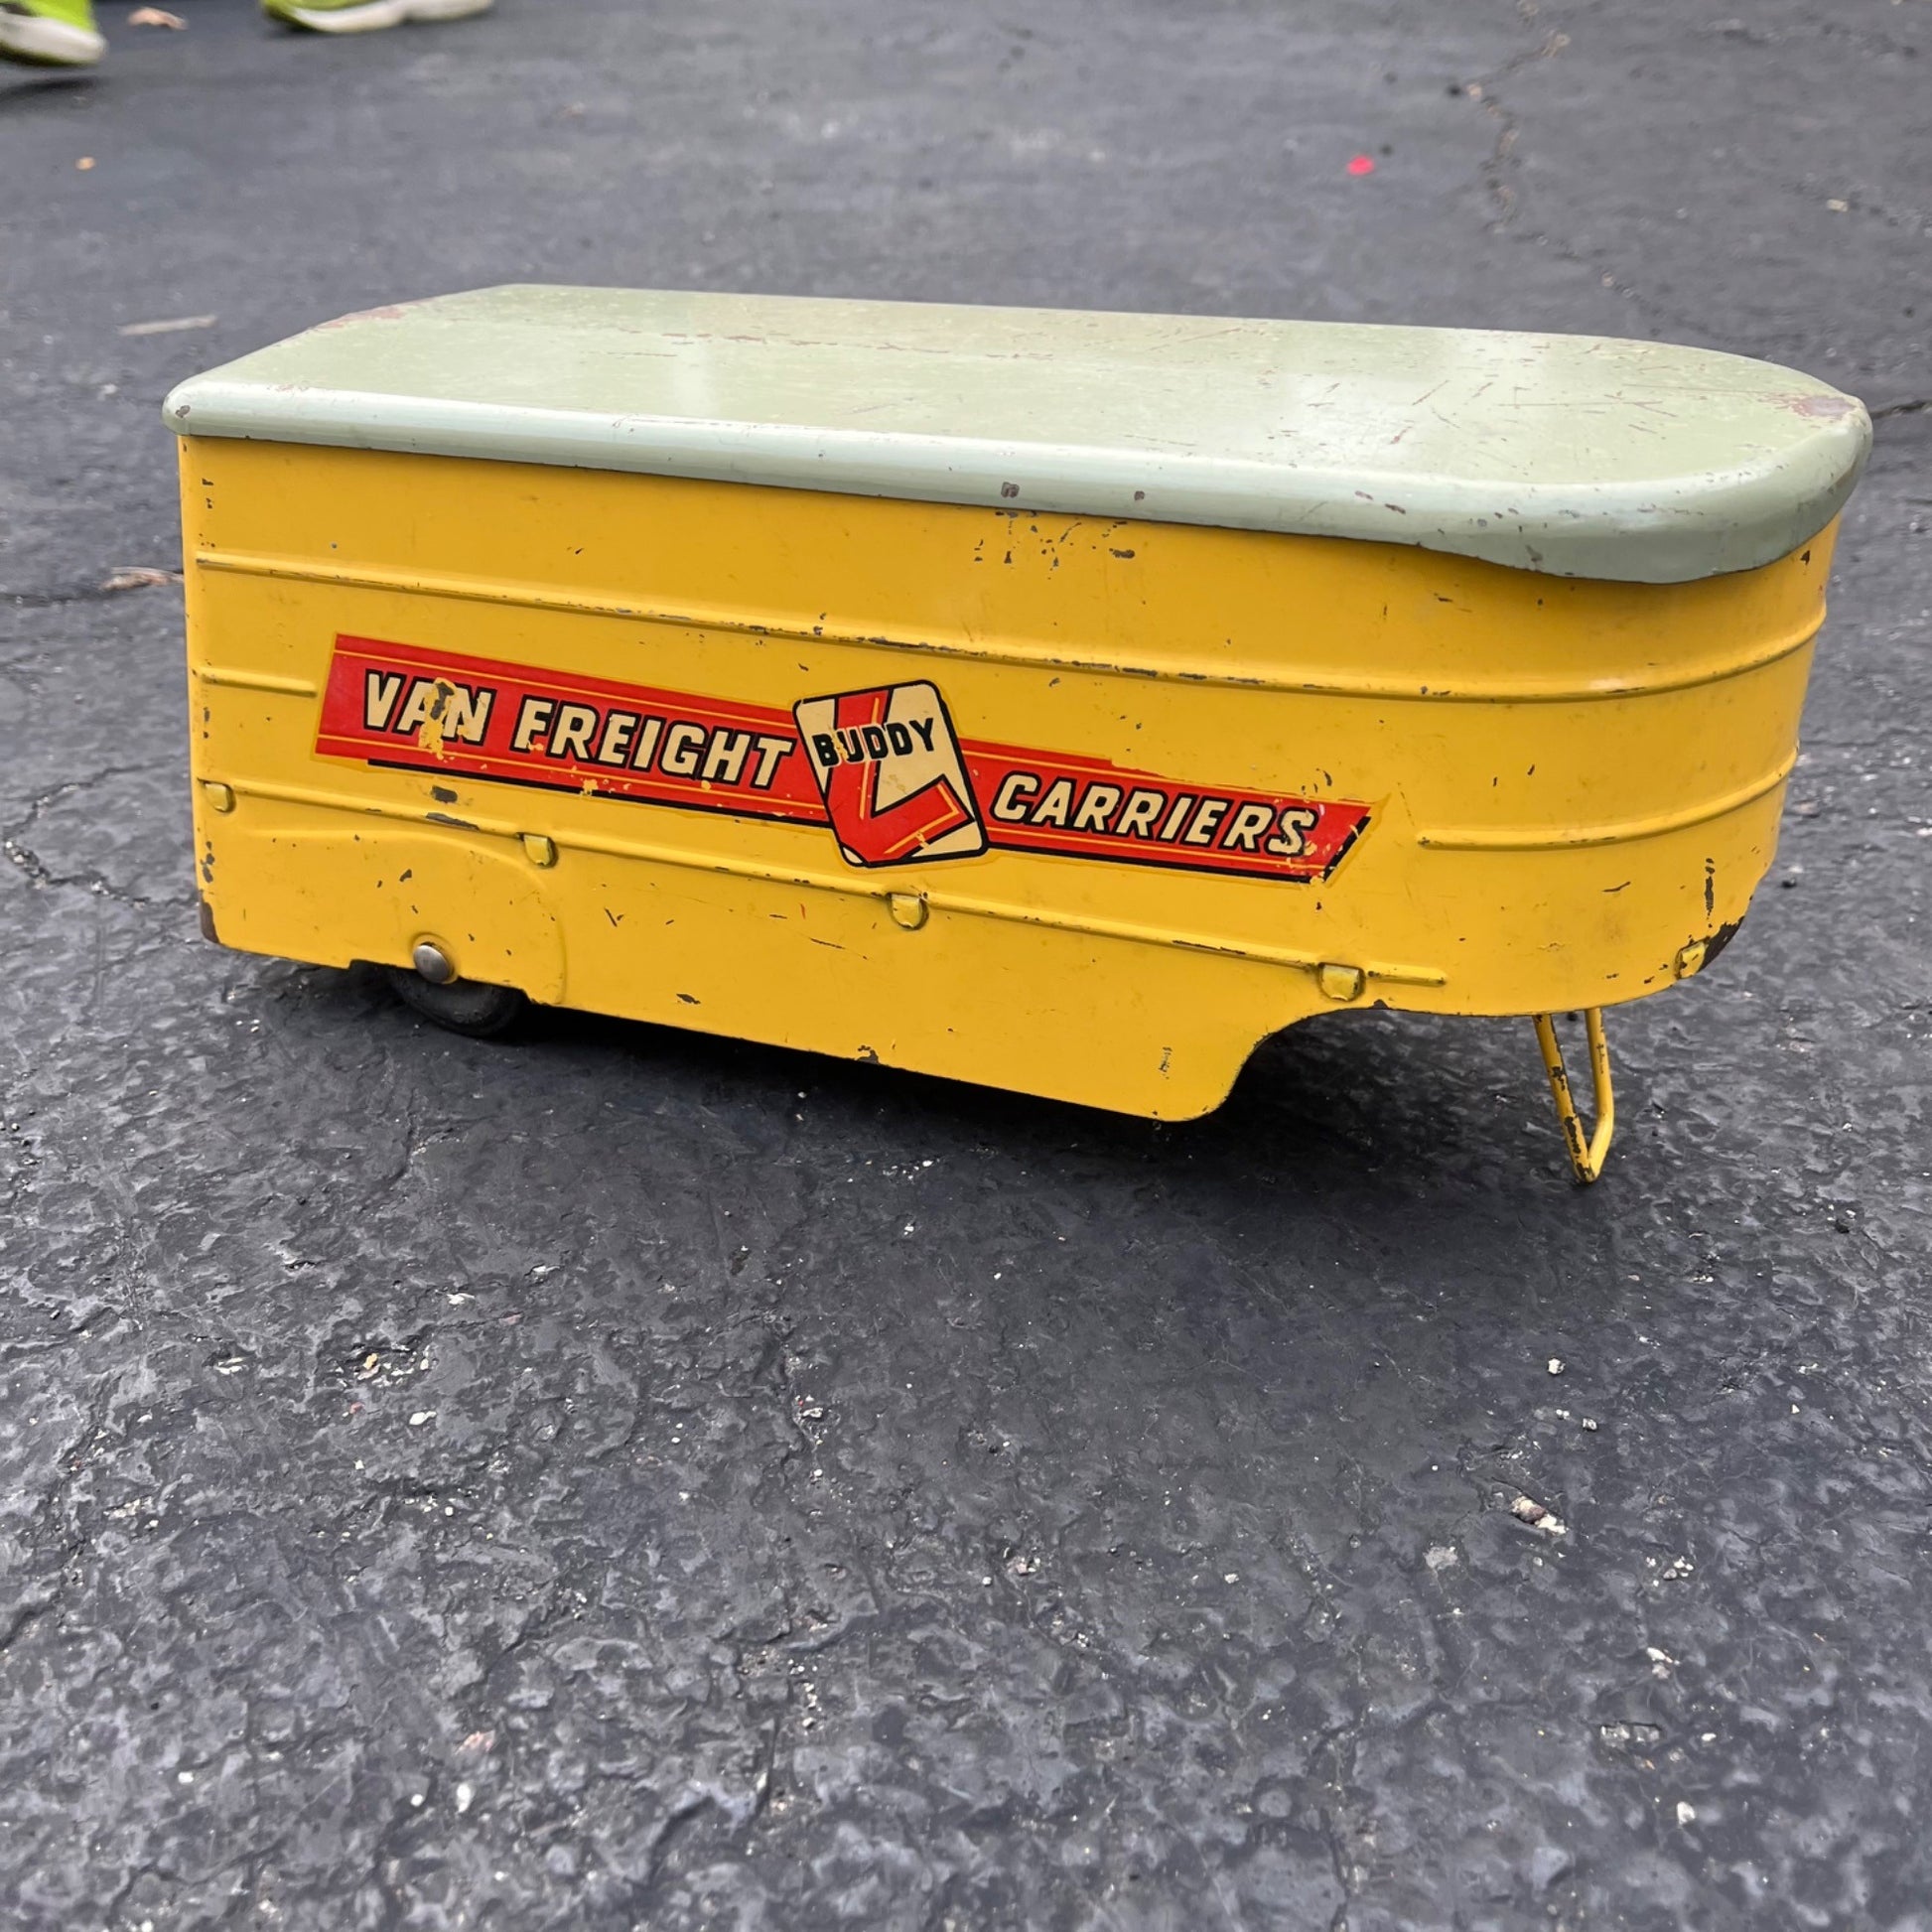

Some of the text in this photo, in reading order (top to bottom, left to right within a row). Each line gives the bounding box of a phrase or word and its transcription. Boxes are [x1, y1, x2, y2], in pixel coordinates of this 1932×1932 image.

[364, 670, 795, 790] VAN FREIGHT
[812, 718, 934, 766] BUDDY
[991, 772, 1317, 856] CARRIERS
